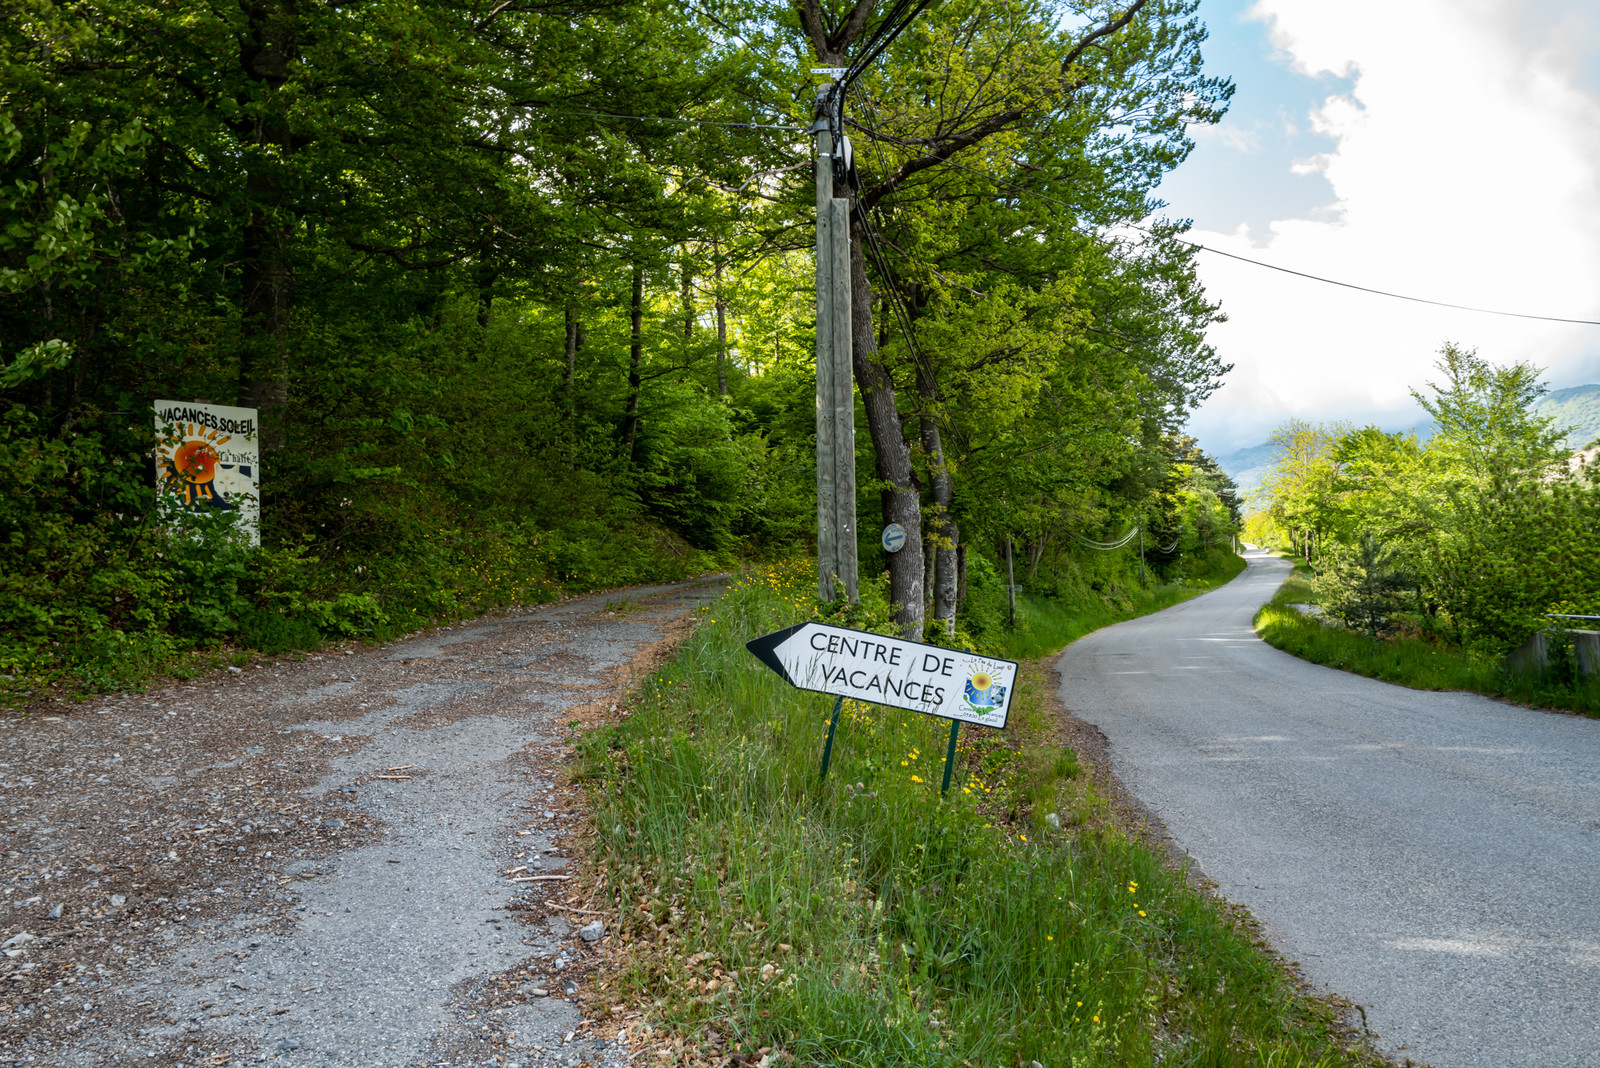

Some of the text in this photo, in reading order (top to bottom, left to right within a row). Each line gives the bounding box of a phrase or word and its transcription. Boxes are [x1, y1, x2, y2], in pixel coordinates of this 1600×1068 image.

[160, 407, 255, 434] VACANCES SOLEIL
[810, 632, 955, 677] CENTRE DE
[821, 664, 945, 706] VACANCES
